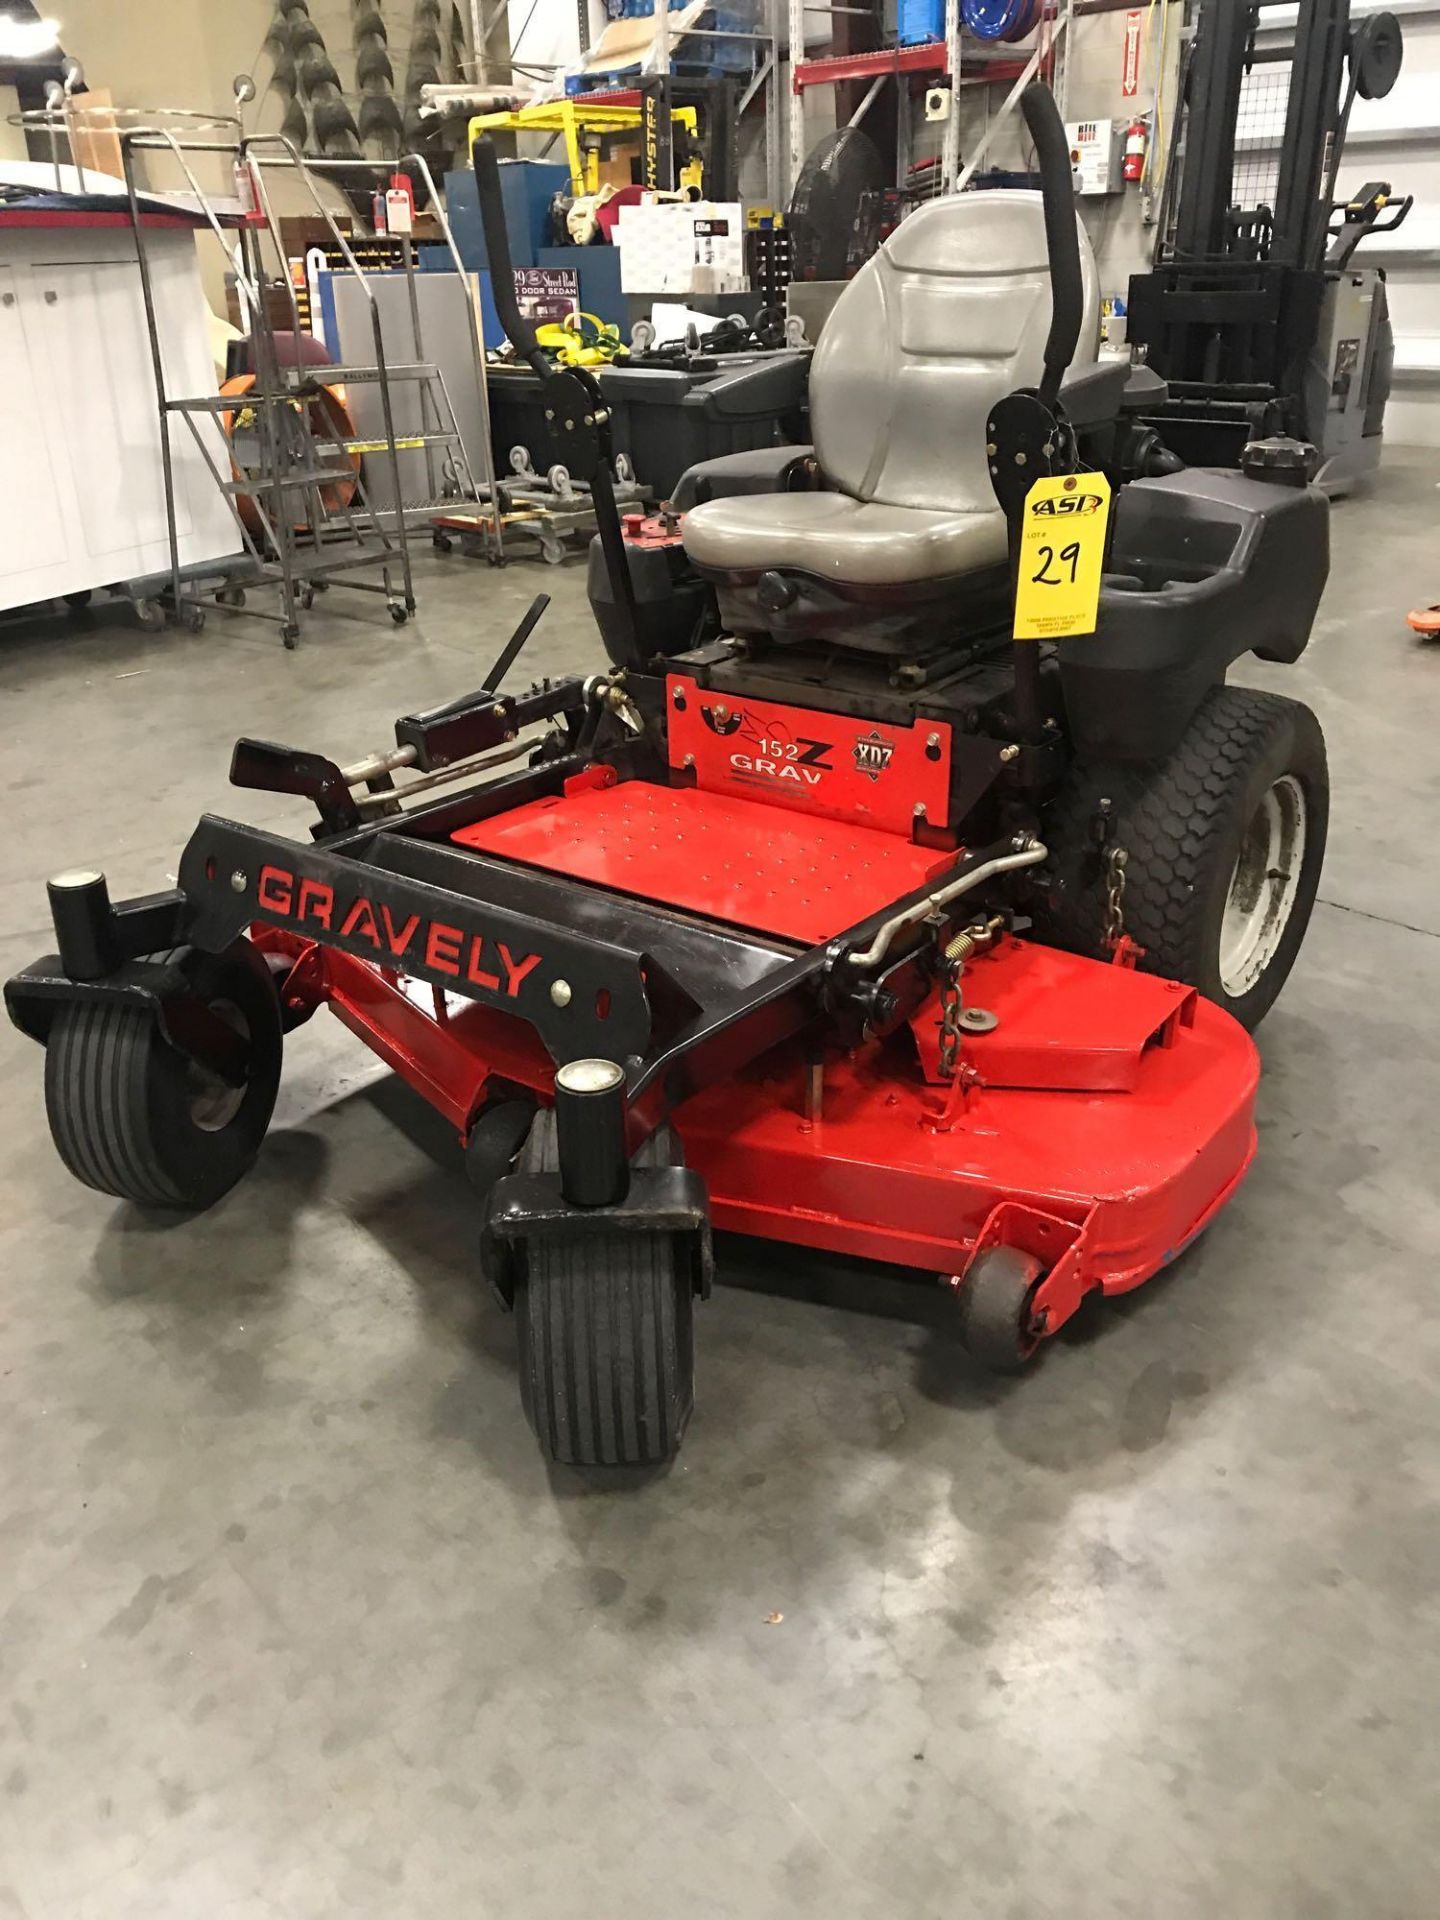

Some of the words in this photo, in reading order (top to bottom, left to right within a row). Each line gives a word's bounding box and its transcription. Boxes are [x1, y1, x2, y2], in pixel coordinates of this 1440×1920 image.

[646, 96, 657, 190] HYSTER
[1032, 542, 1081, 585] 29
[257, 864, 543, 998] GRAVELY
